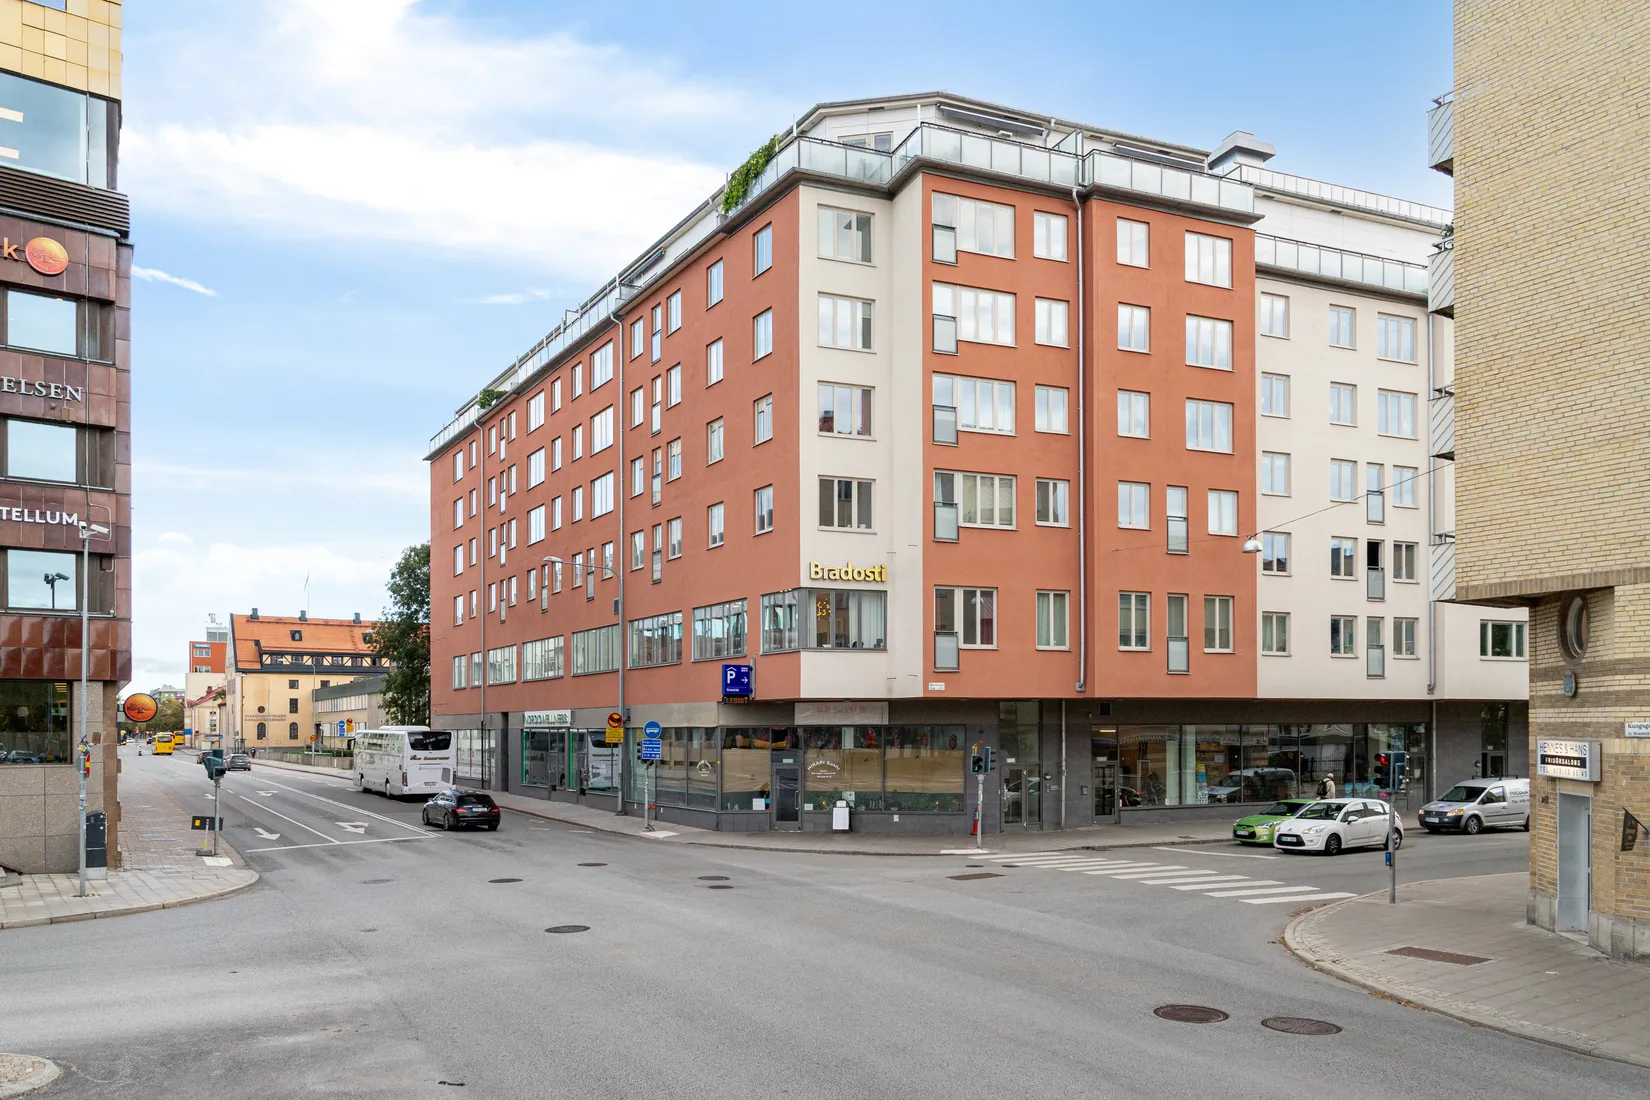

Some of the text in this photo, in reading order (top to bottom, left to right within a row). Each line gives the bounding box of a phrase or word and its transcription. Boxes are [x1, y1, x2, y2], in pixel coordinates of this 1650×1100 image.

[3, 237, 19, 260] k
[1, 375, 84, 402] ELSEN
[0, 506, 78, 526] TELLUM
[809, 561, 887, 582] Bradosti
[727, 670, 736, 684] P
[1540, 742, 1563, 754] HENNES
[1570, 744, 1588, 756] HANS
[1545, 757, 1580, 766] FRISÖRSALONG
